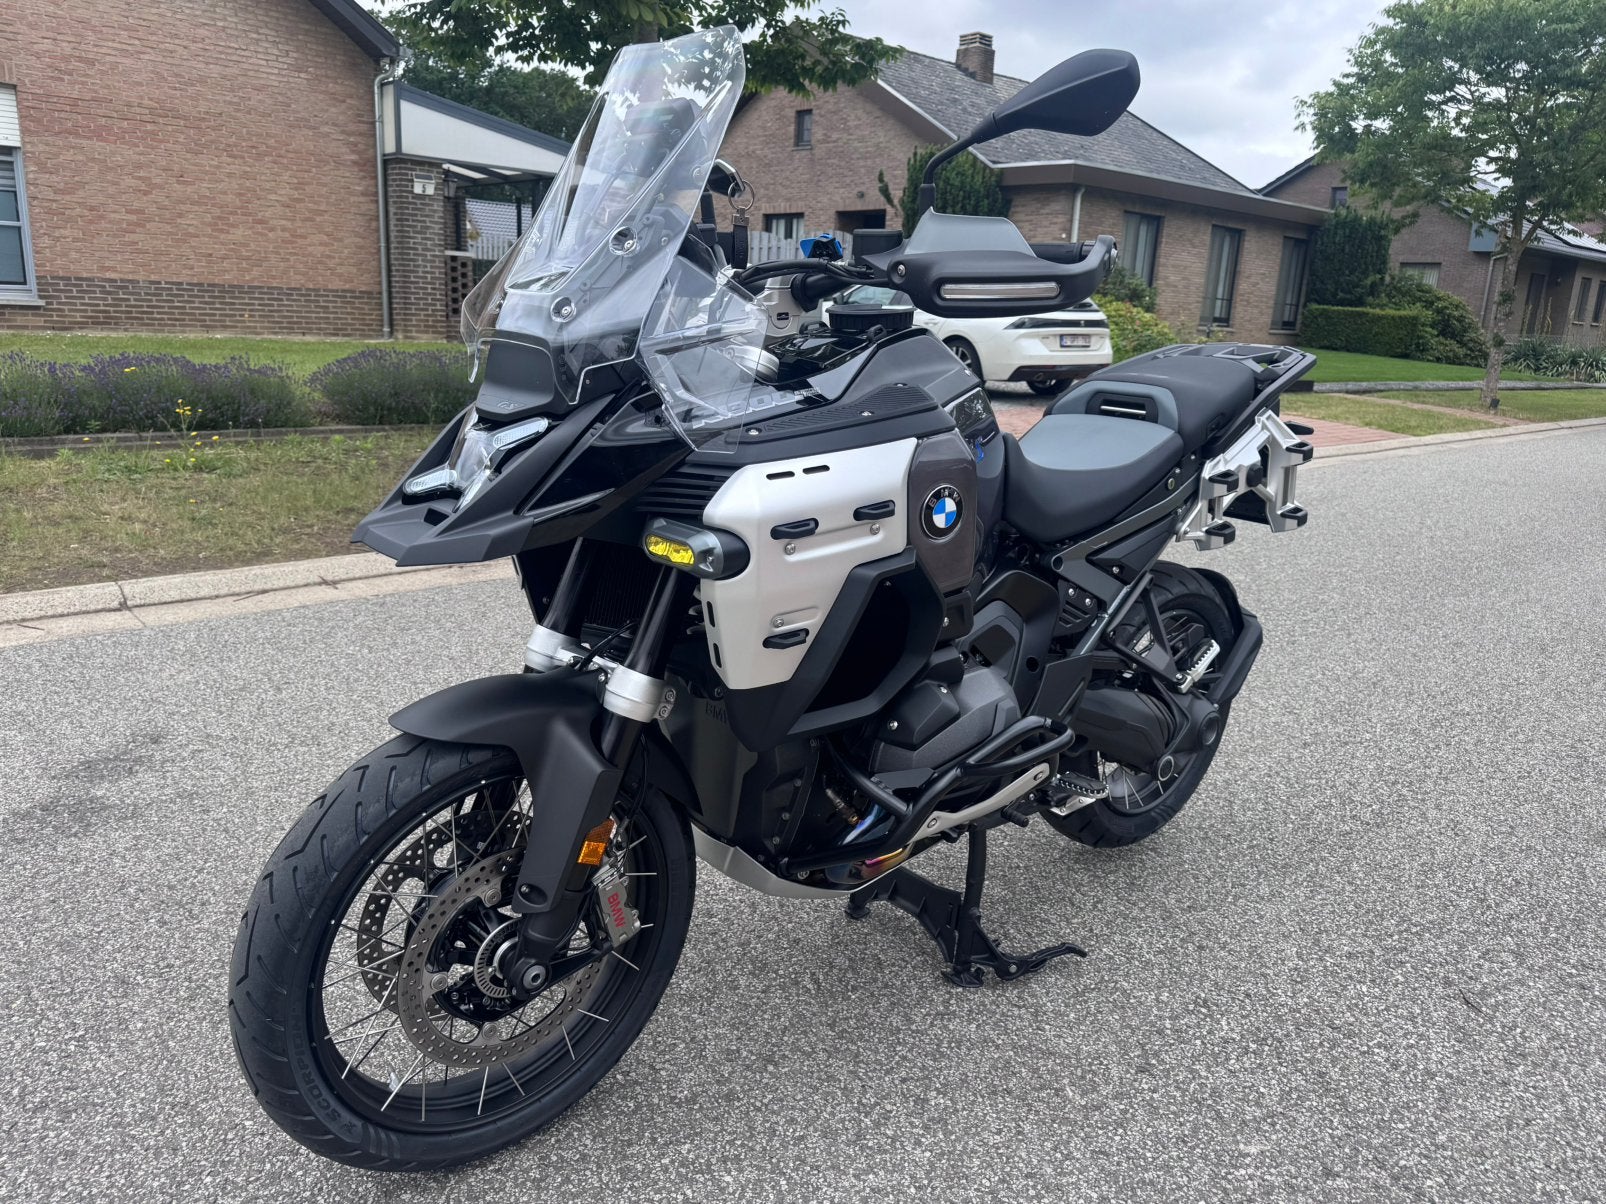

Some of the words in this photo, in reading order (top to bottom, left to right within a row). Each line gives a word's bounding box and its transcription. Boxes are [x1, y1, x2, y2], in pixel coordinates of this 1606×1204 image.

[928, 489, 961, 508] BMW
[705, 700, 728, 724] BM
[607, 892, 626, 928] BMW
